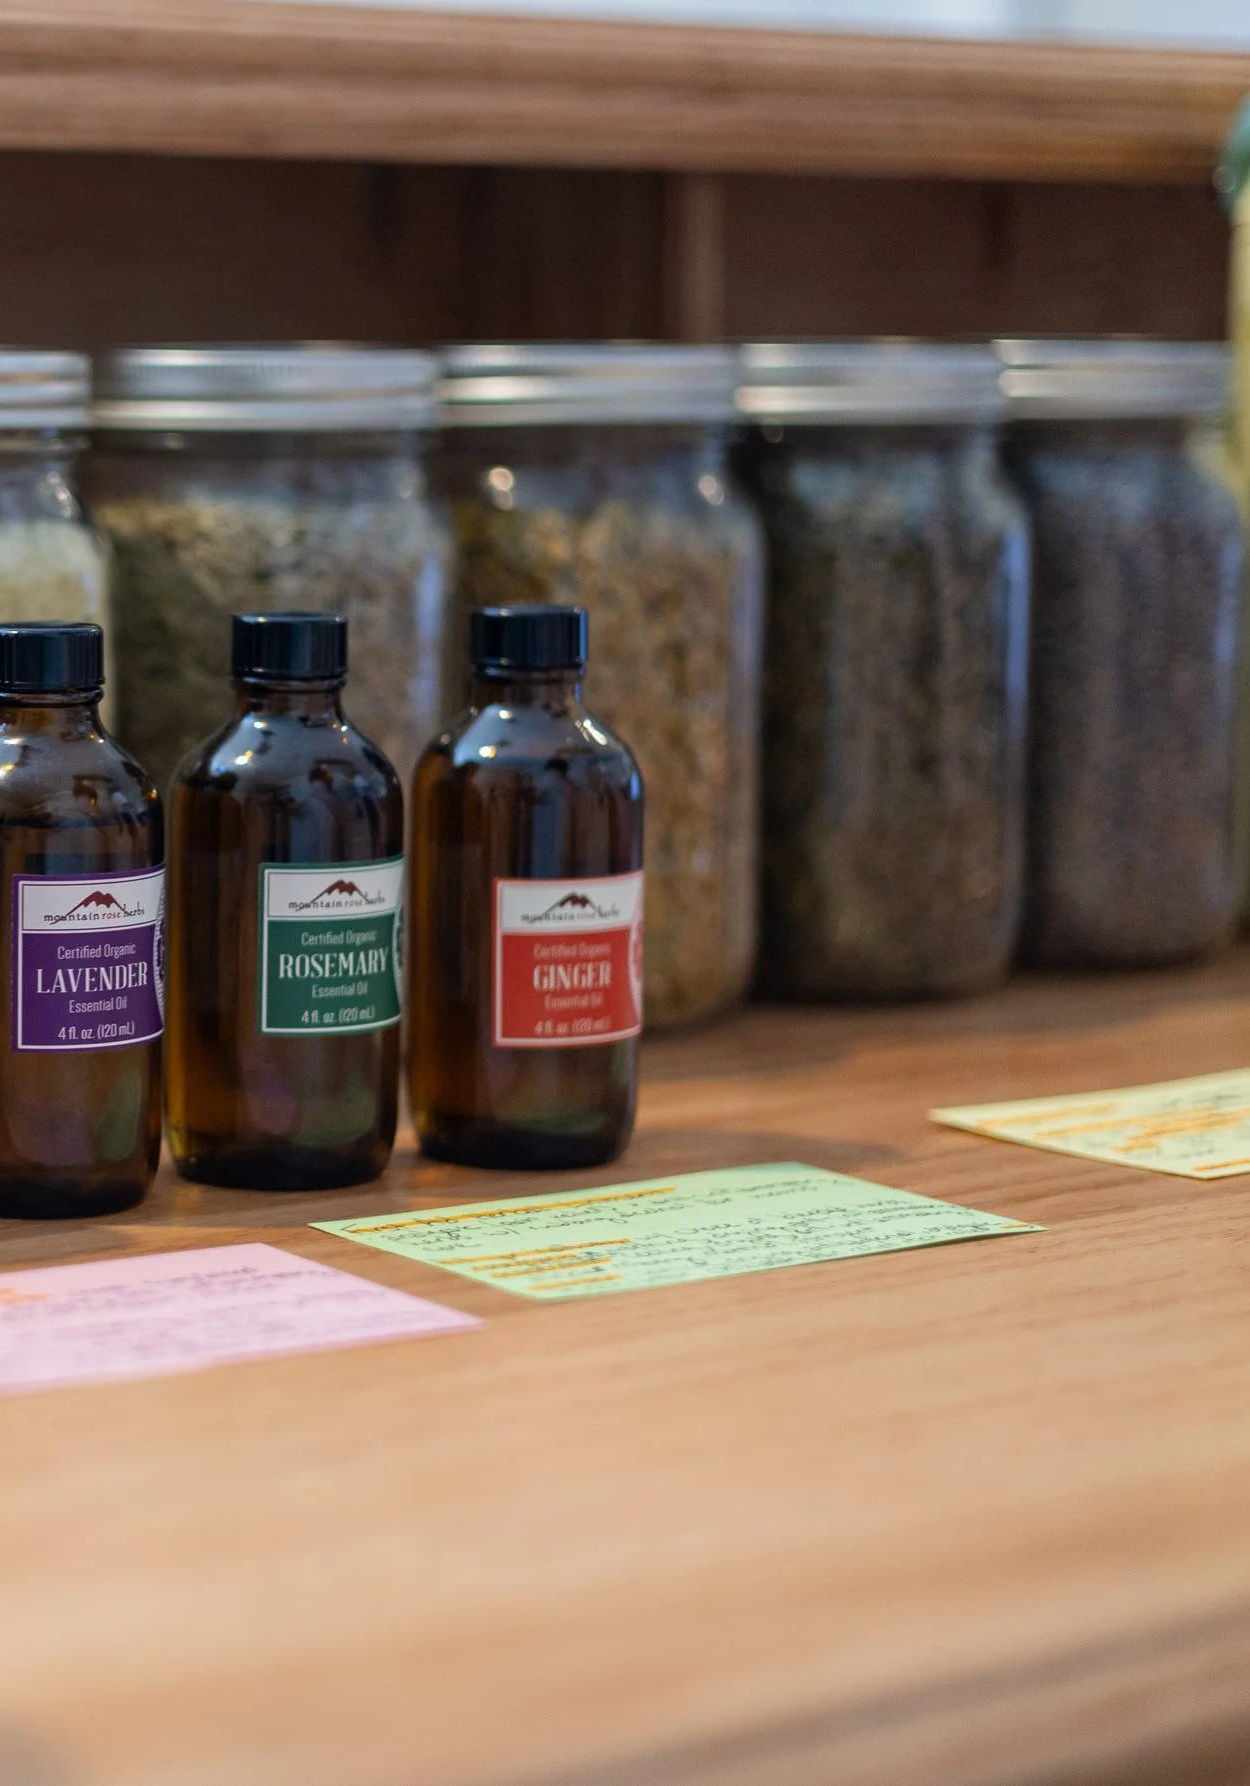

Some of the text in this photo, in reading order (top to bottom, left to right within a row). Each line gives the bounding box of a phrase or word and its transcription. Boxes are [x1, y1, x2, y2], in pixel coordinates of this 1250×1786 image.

[44, 902, 145, 922] mountain rose herbs
[289, 901, 342, 909] mountain
[301, 930, 377, 946] Certified Organic
[57, 943, 136, 960] Certified Organic
[534, 944, 576, 959] Certified
[279, 946, 388, 978] ROSEMARY
[36, 961, 148, 993] LAVENDER
[533, 961, 612, 991] GINGER
[312, 981, 368, 998] Essential Oil
[69, 996, 127, 1013] Essential Oil
[301, 1011, 309, 1023] 4
[339, 1008, 357, 1023] (120
[58, 1026, 66, 1039] 4
[98, 1023, 117, 1040] (120
